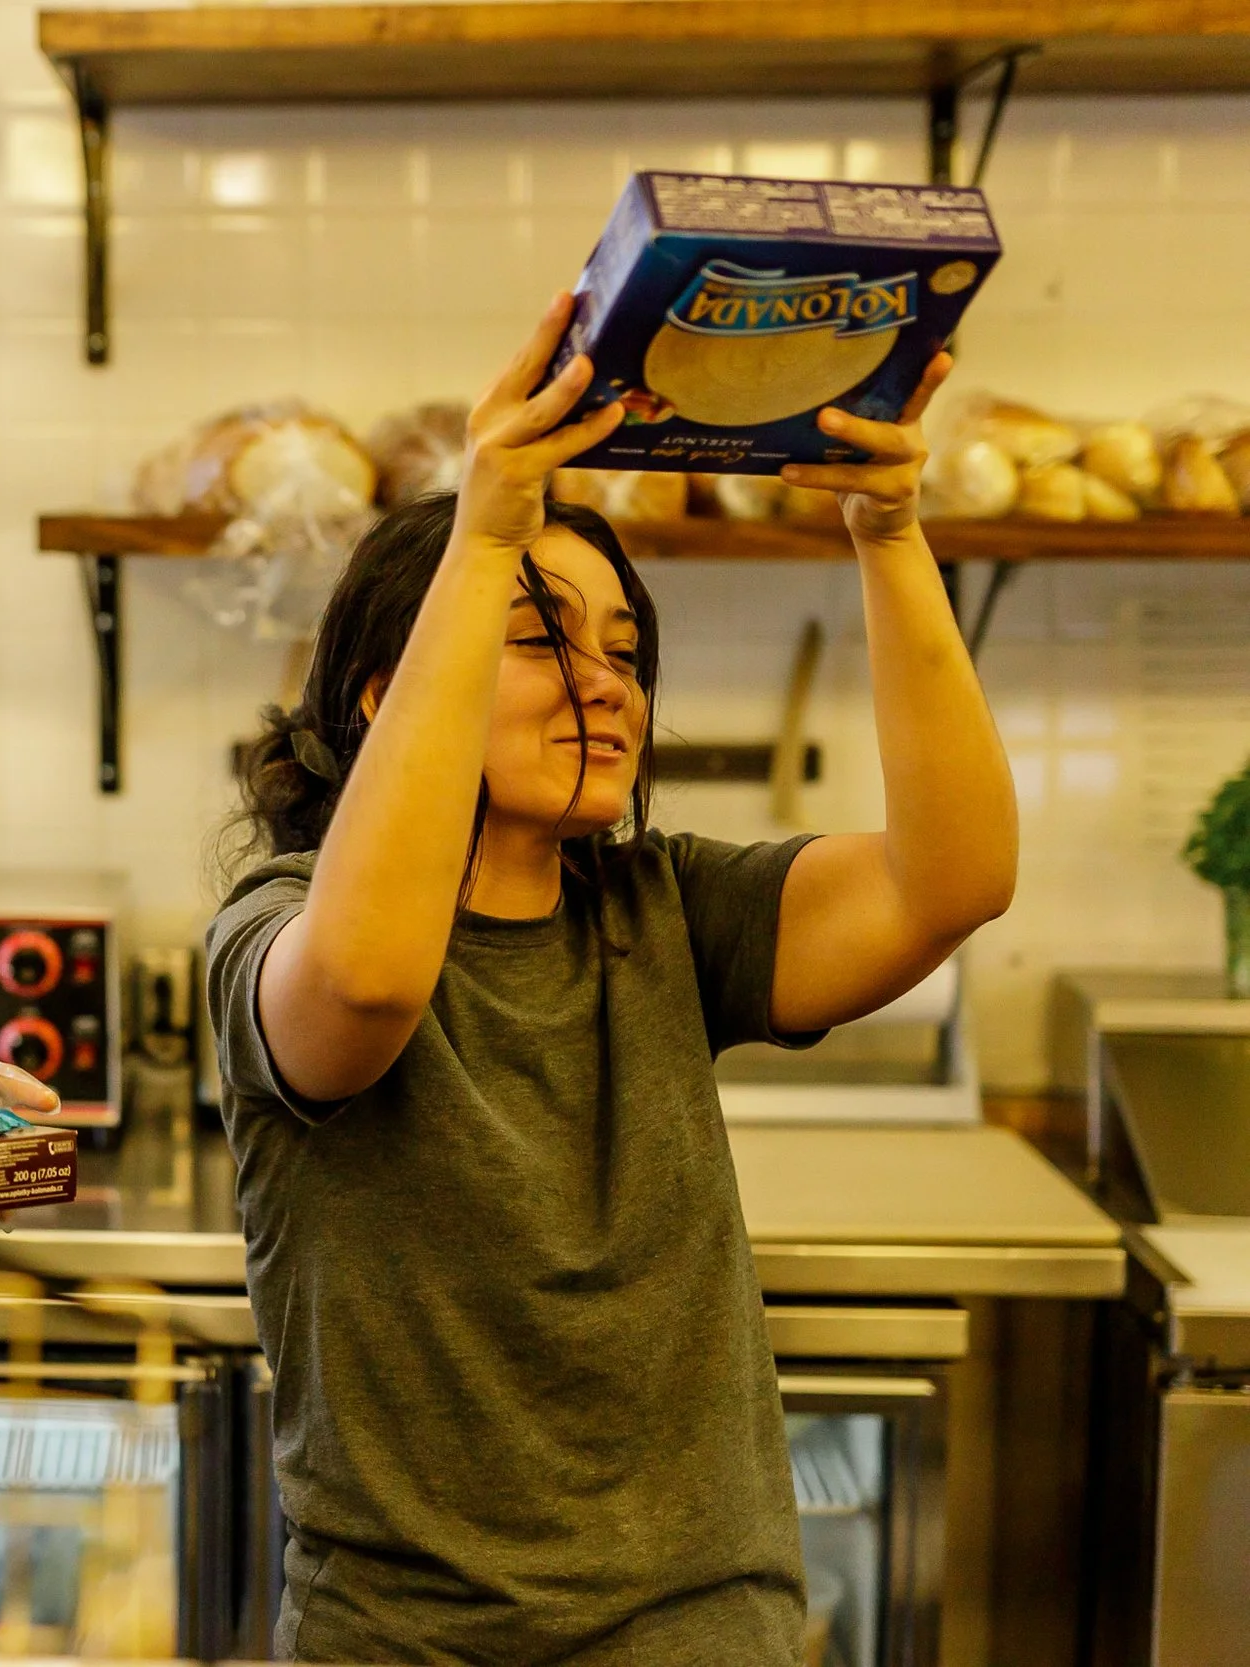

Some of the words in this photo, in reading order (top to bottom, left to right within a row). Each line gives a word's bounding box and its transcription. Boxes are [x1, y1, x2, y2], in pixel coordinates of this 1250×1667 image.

[687, 286, 908, 330] KOLONADA
[661, 436, 754, 447] HAZELNUT
[13, 1170, 29, 1182] 200
[30, 1171, 37, 1183] g
[38, 1167, 57, 1180] (7,05
[58, 1165, 71, 1177] oz)
